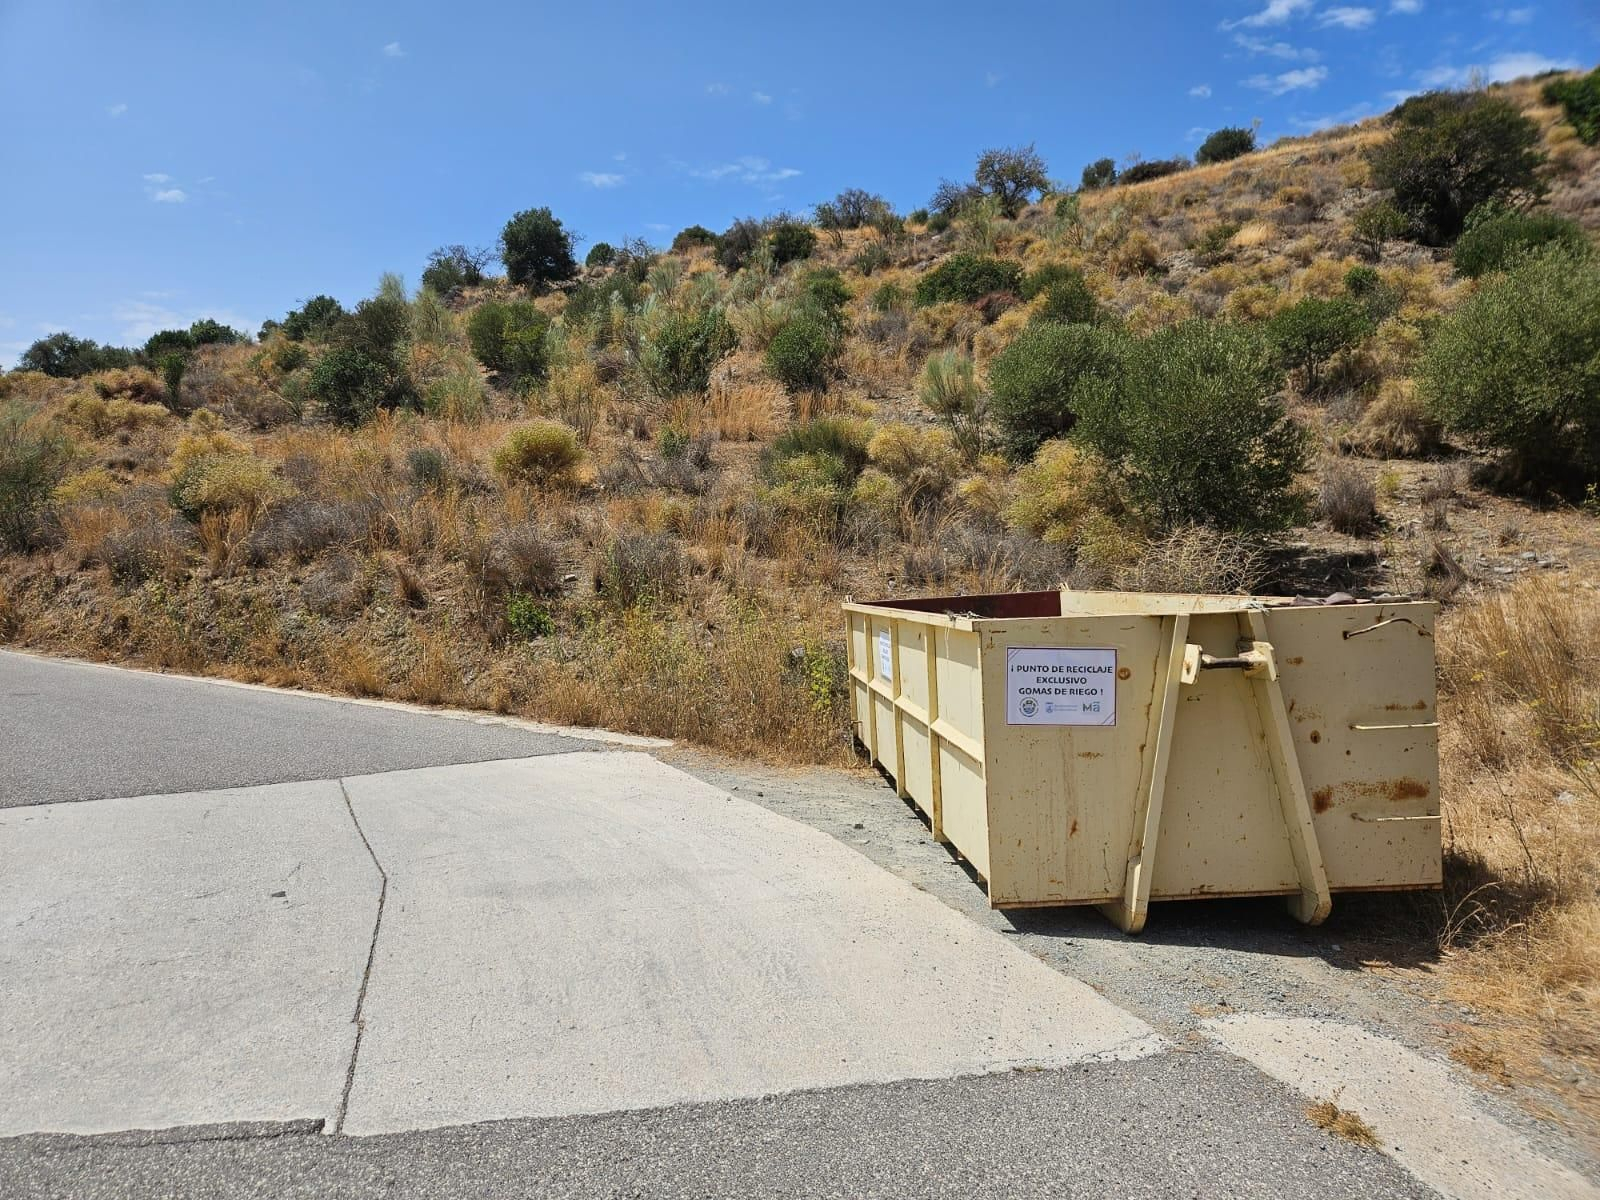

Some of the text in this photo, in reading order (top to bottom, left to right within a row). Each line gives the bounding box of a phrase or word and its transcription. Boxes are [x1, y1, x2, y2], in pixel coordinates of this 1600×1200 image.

[1016, 665, 1050, 673] PUNTO
[1051, 665, 1065, 673] DE
[1018, 687, 1052, 695] GOMAS
[1054, 688, 1068, 696] DE
[1069, 688, 1098, 696] RIEGO
